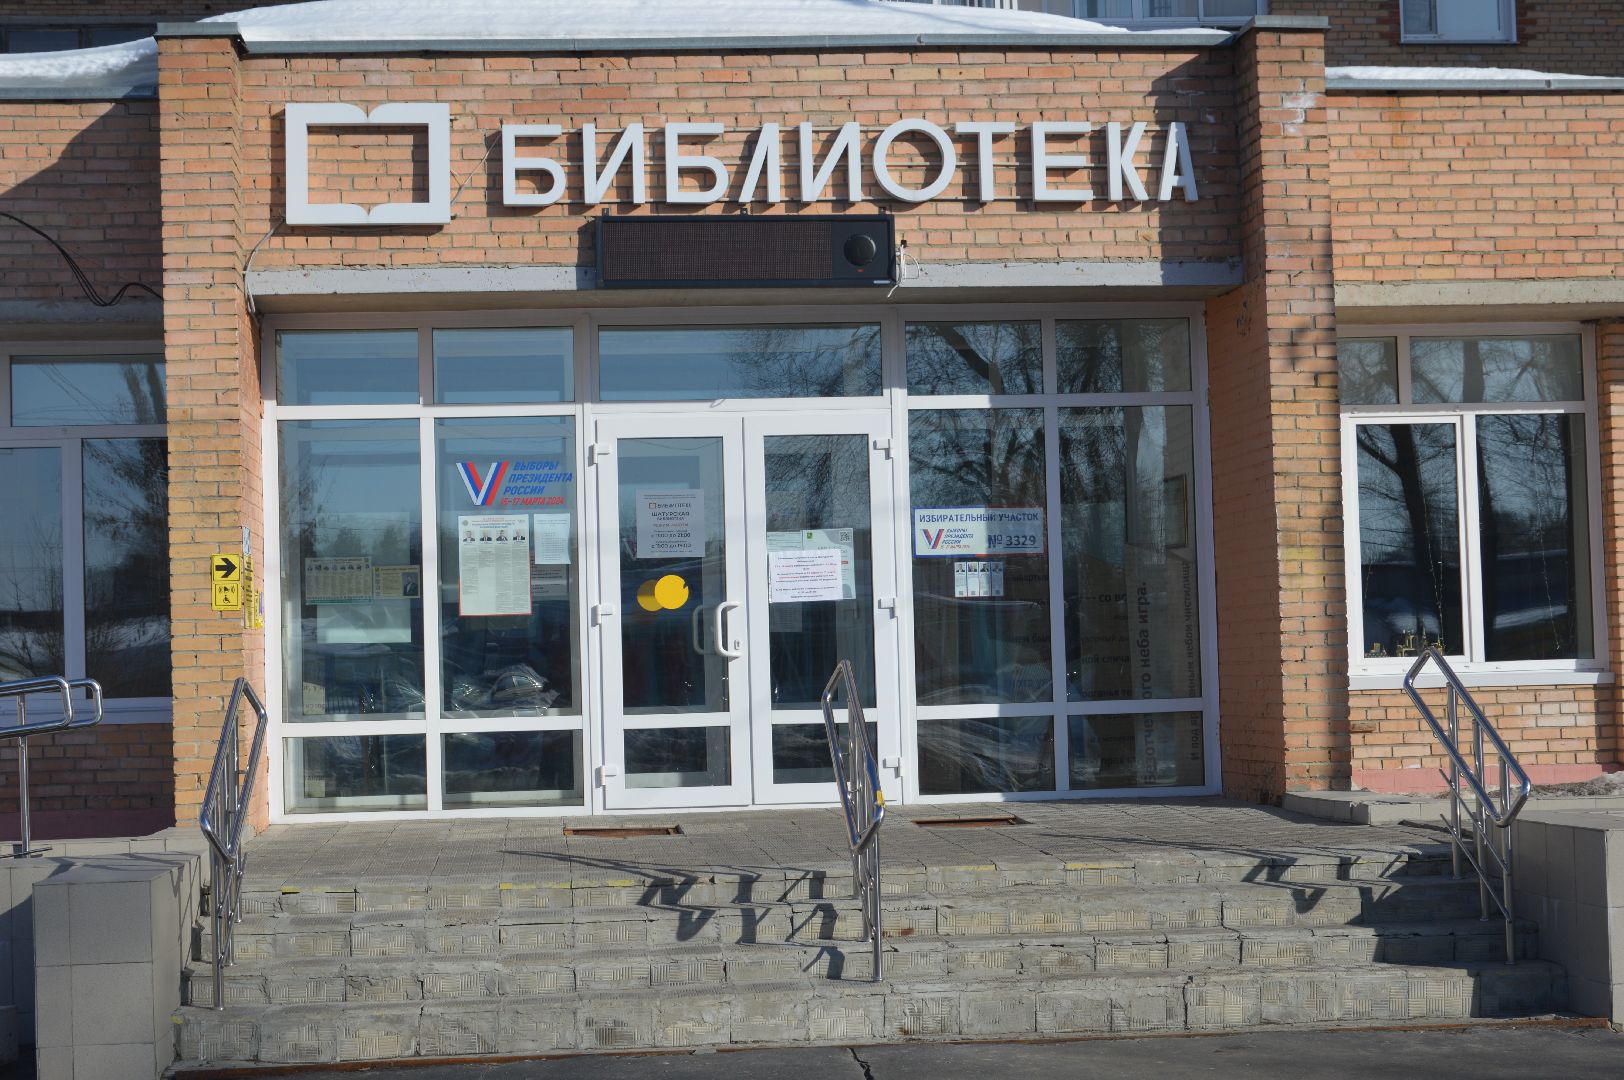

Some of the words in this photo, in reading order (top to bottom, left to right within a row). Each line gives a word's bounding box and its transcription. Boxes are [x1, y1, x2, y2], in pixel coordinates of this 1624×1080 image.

[502, 118, 1199, 208] БИБЛИОТЕКА
[513, 461, 560, 471] ВЫБОРЫ
[508, 472, 573, 484] ПРЕЗИДЕНТА
[503, 485, 546, 496] РОССИИ
[919, 513, 995, 523] ИЗБИРАТЕЛЬНЫЙ
[999, 512, 1039, 522] УЧАСТОК
[987, 534, 1003, 549] №
[1005, 535, 1037, 546] 3329
[1135, 581, 1151, 624] игра.
[1137, 629, 1152, 668] неба
[1189, 728, 1201, 749] под
